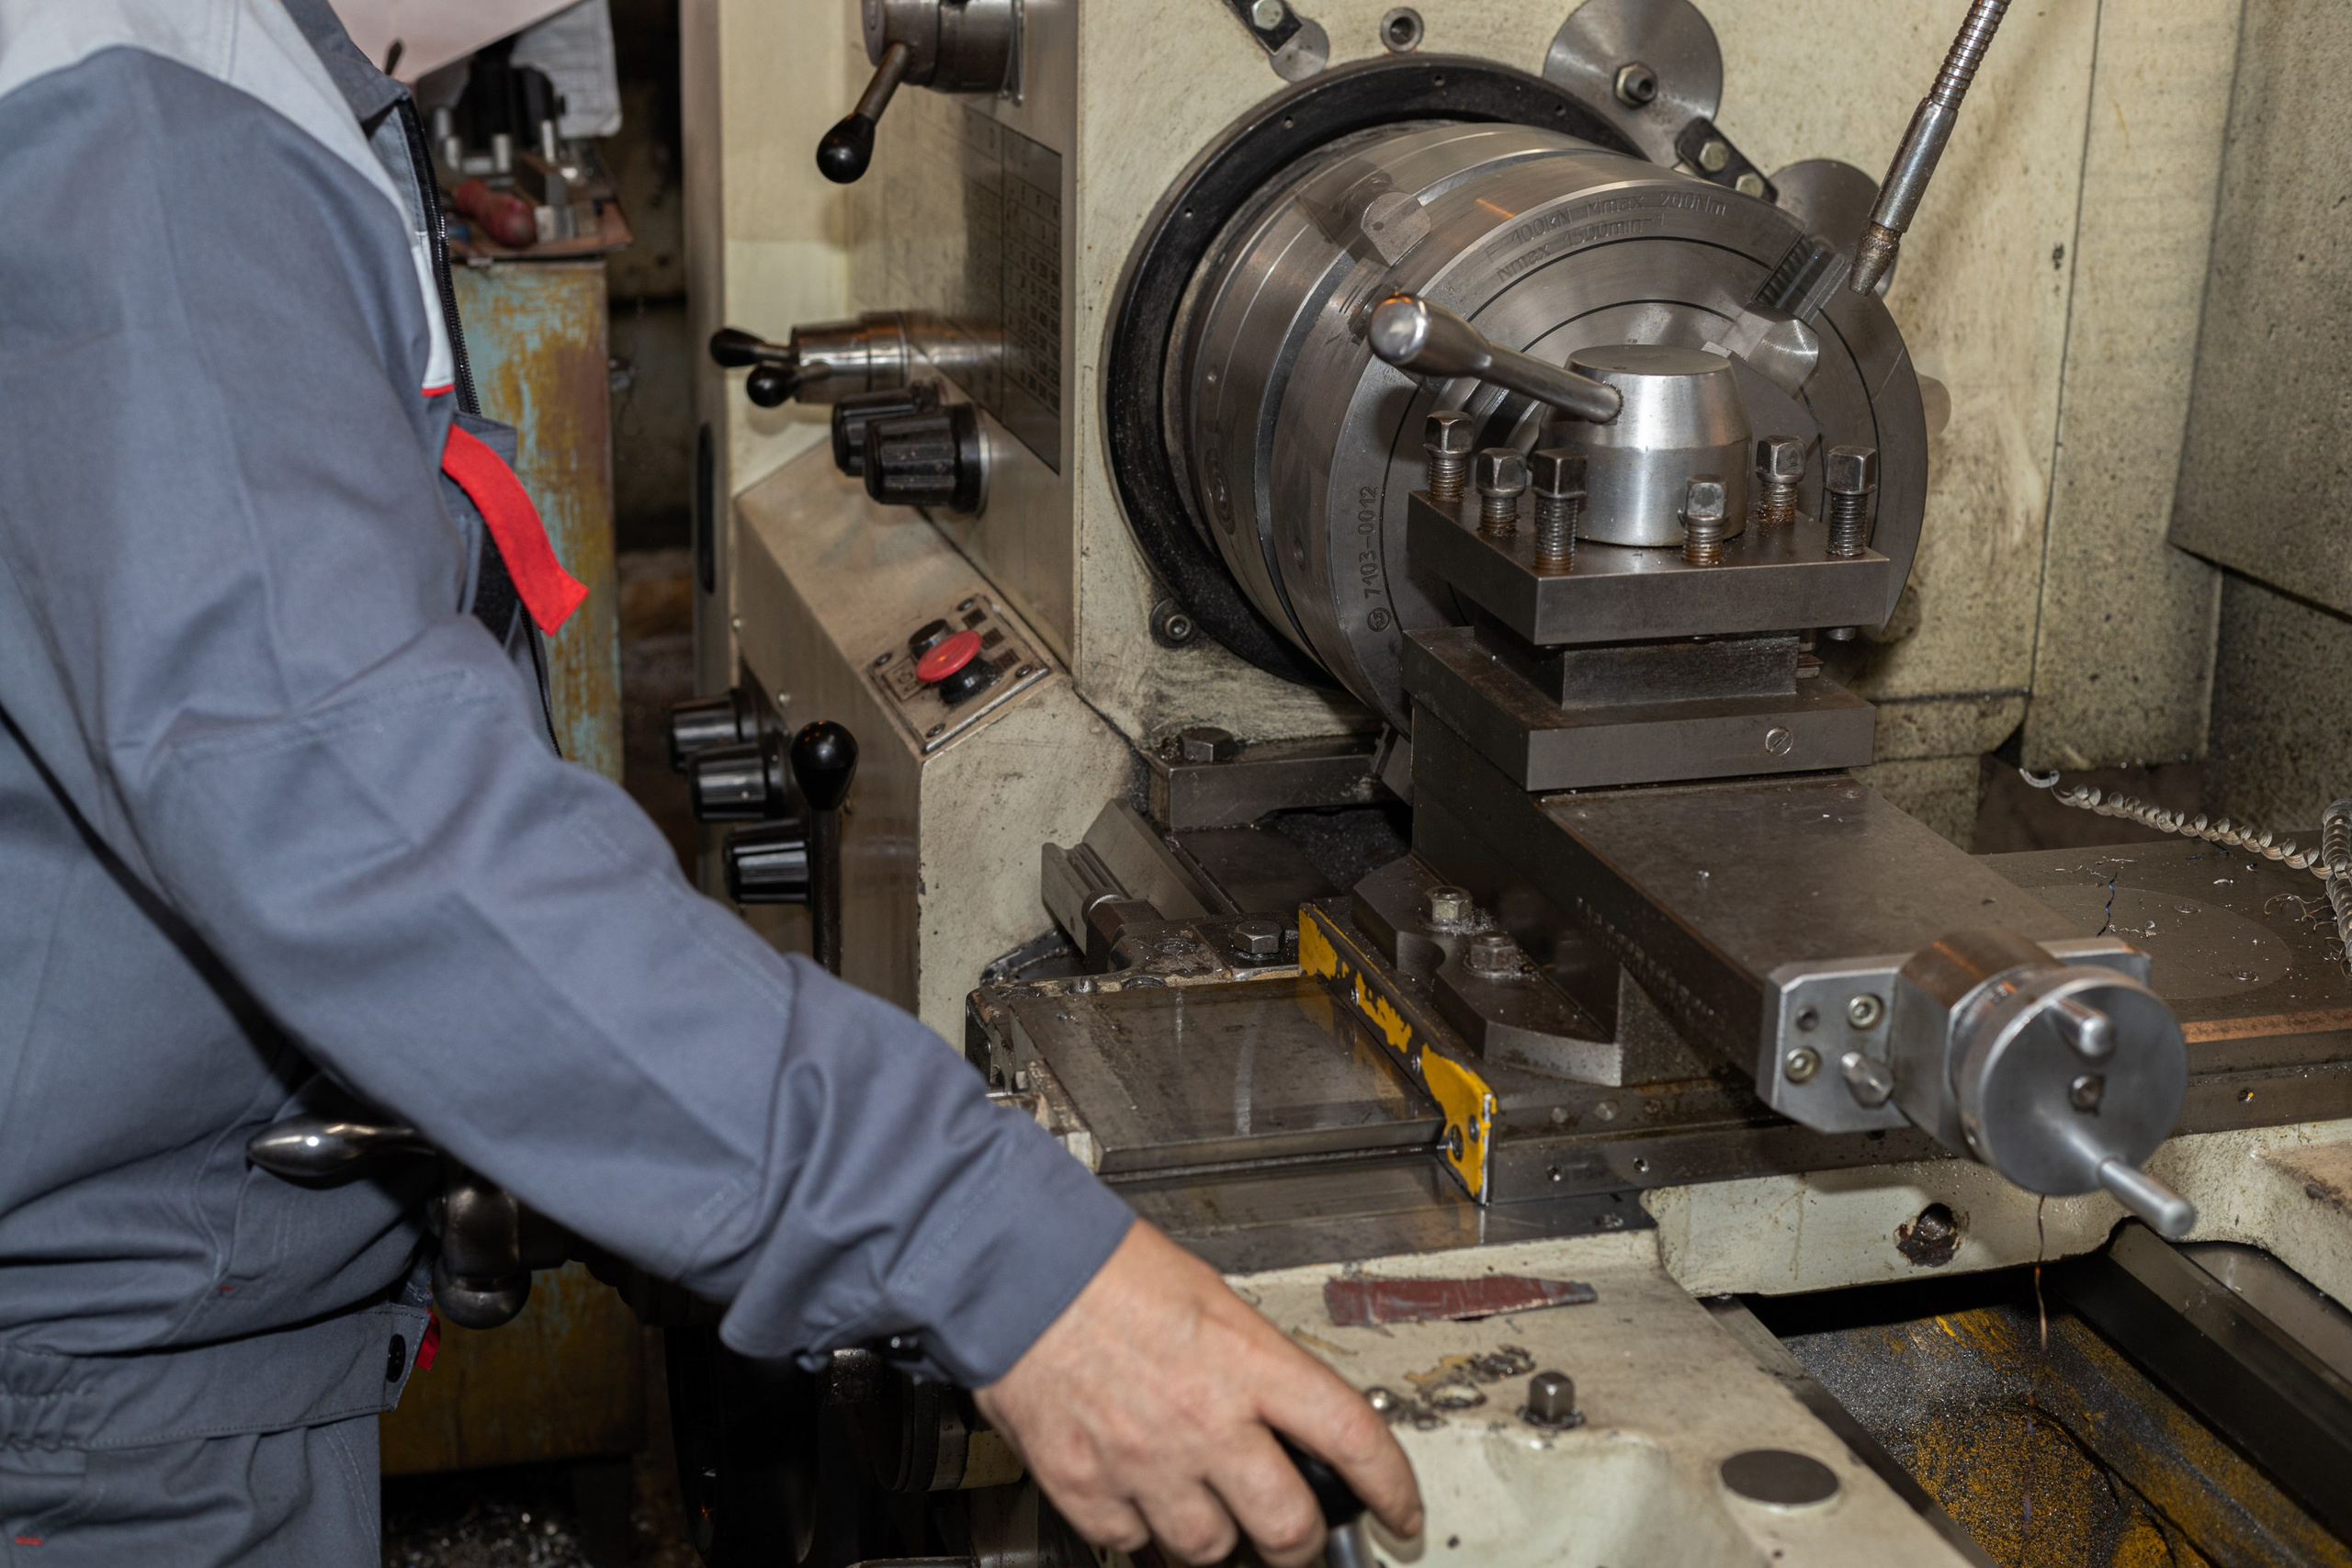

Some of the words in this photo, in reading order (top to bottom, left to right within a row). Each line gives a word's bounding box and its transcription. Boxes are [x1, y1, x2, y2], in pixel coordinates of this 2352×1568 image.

[1511, 207, 1574, 245] 100kN
[1586, 196, 1645, 219] Mmax
[1659, 191, 1727, 217] 200Nm
[1357, 485, 1382, 600] 7103-0012
